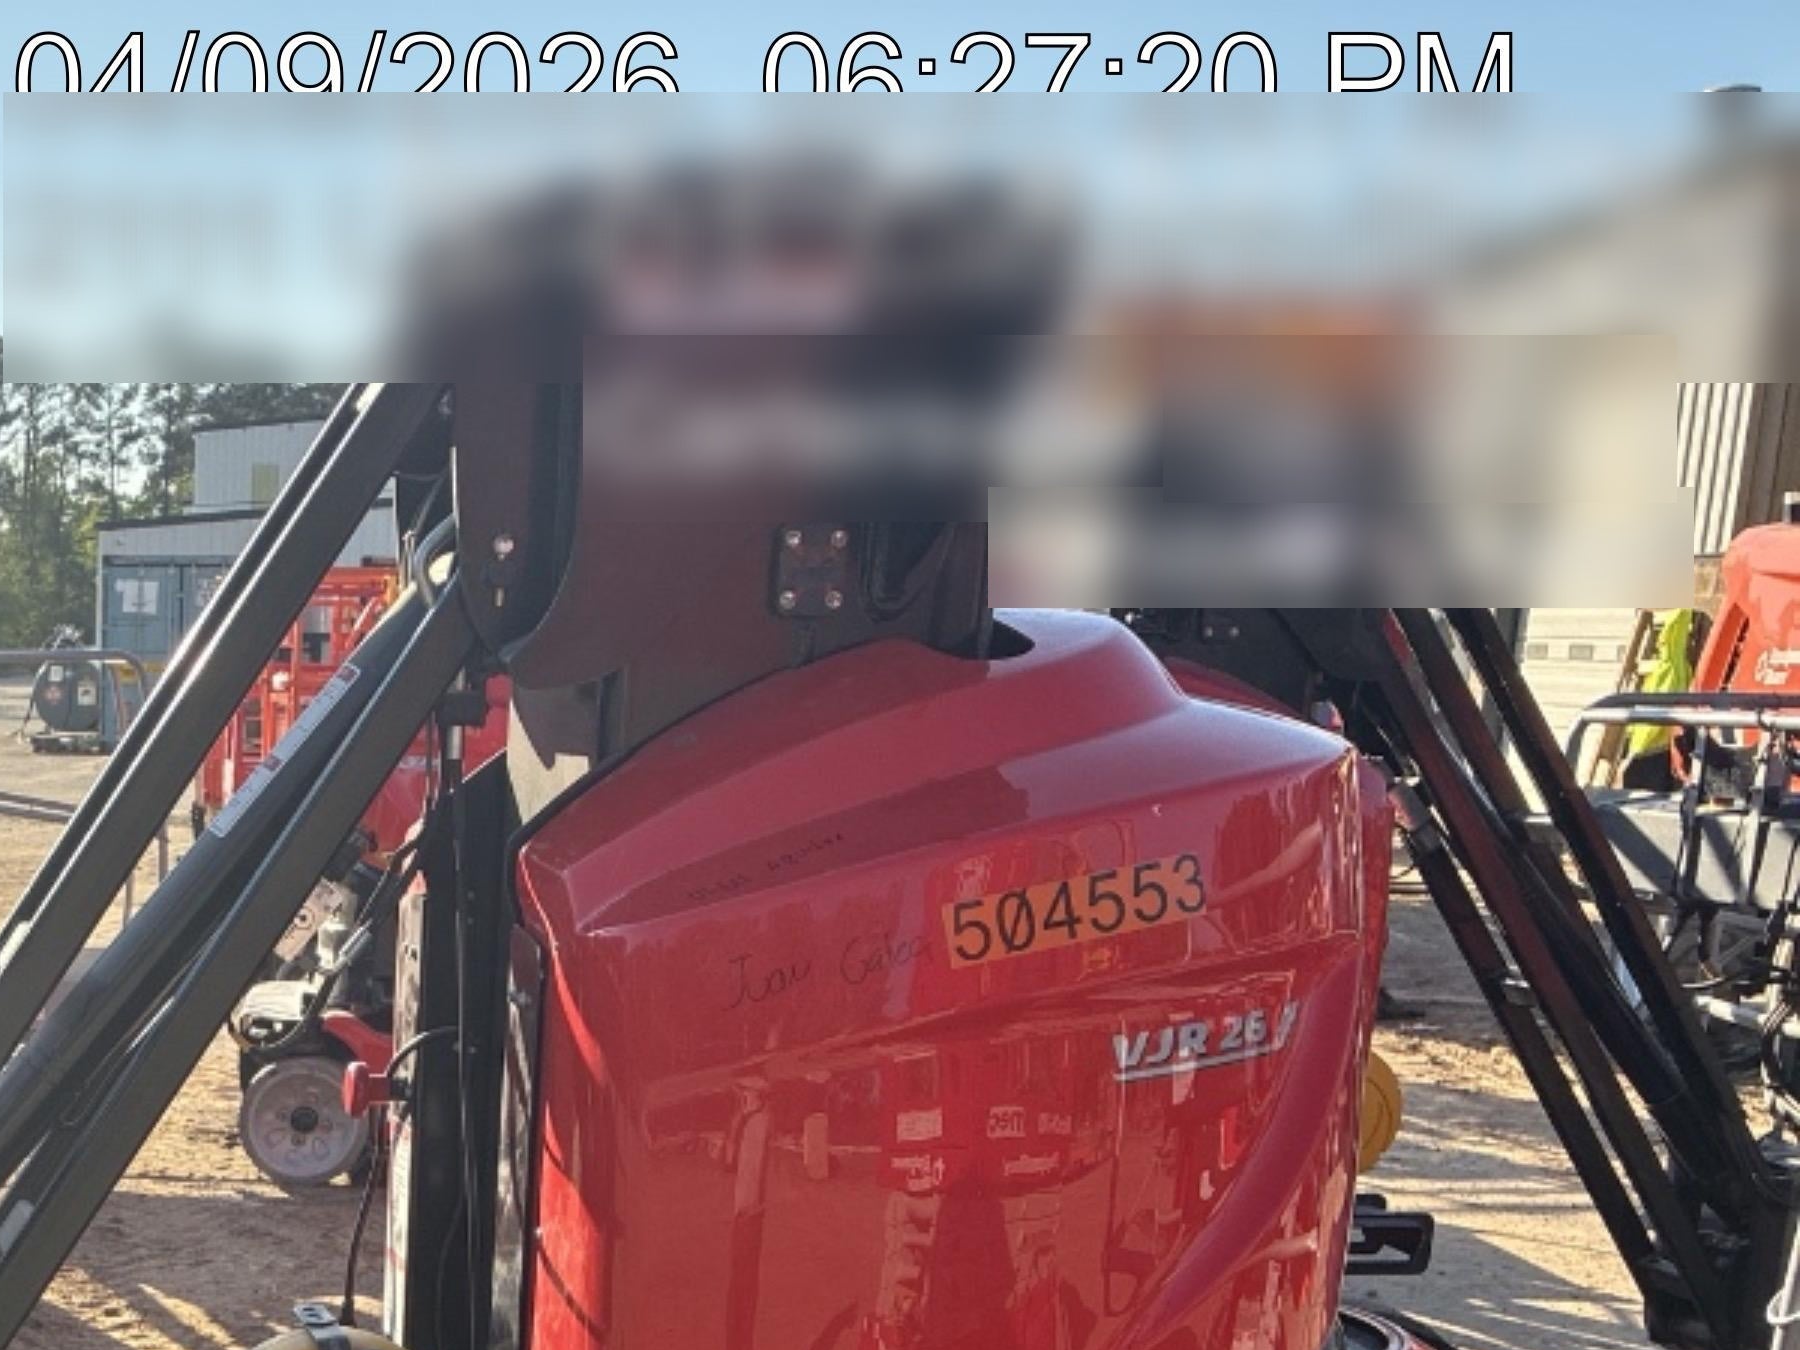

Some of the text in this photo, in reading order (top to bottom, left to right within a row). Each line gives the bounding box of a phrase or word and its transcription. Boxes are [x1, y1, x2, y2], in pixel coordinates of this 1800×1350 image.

[952, 853, 1207, 961] 504553
[1111, 1008, 1268, 1068] VJR 26
